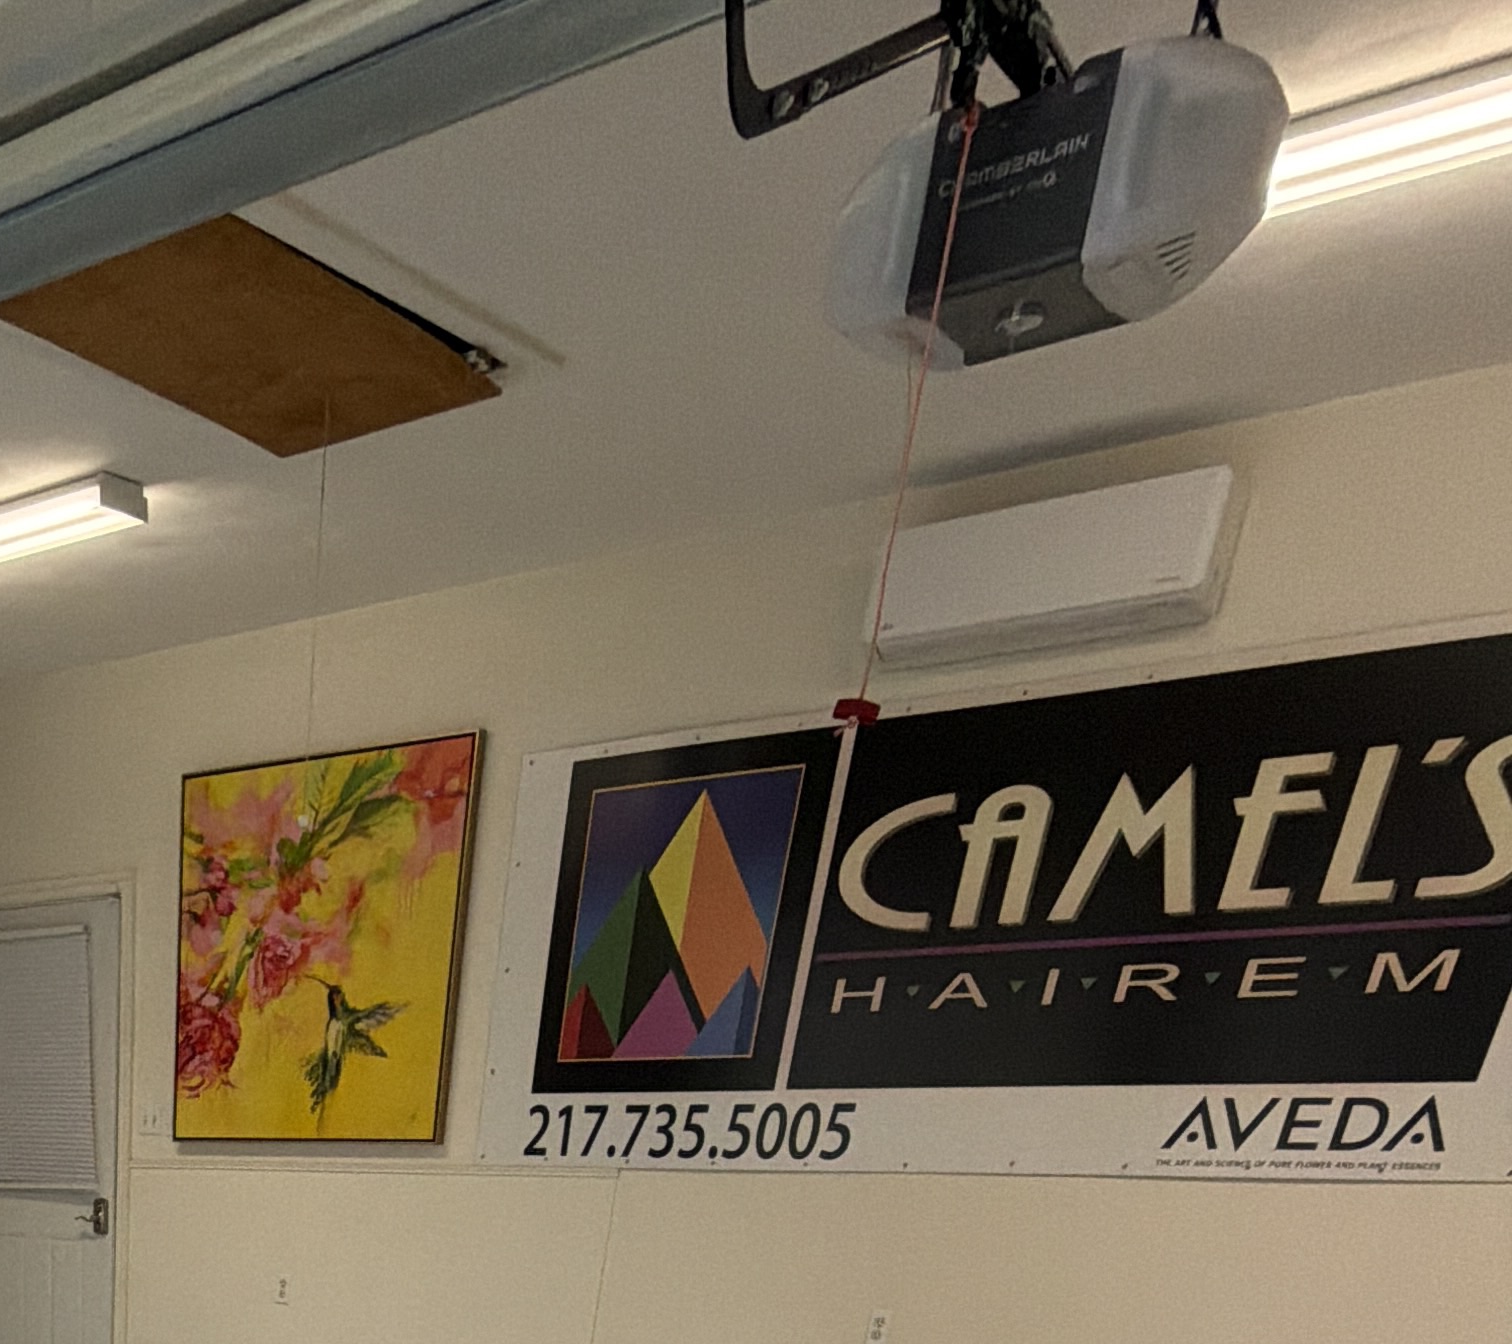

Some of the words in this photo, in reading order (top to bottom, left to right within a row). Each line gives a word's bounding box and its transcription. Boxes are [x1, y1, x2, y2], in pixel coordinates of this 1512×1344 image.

[938, 132, 1091, 198] CAMBERLAIN
[838, 732, 1512, 932] CAMEL'S
[523, 1102, 856, 1160] 217.735.5005
[1160, 1095, 1445, 1151] AVEDA
[1254, 1160, 1267, 1168] OF
[1334, 1161, 1355, 1170] AND
